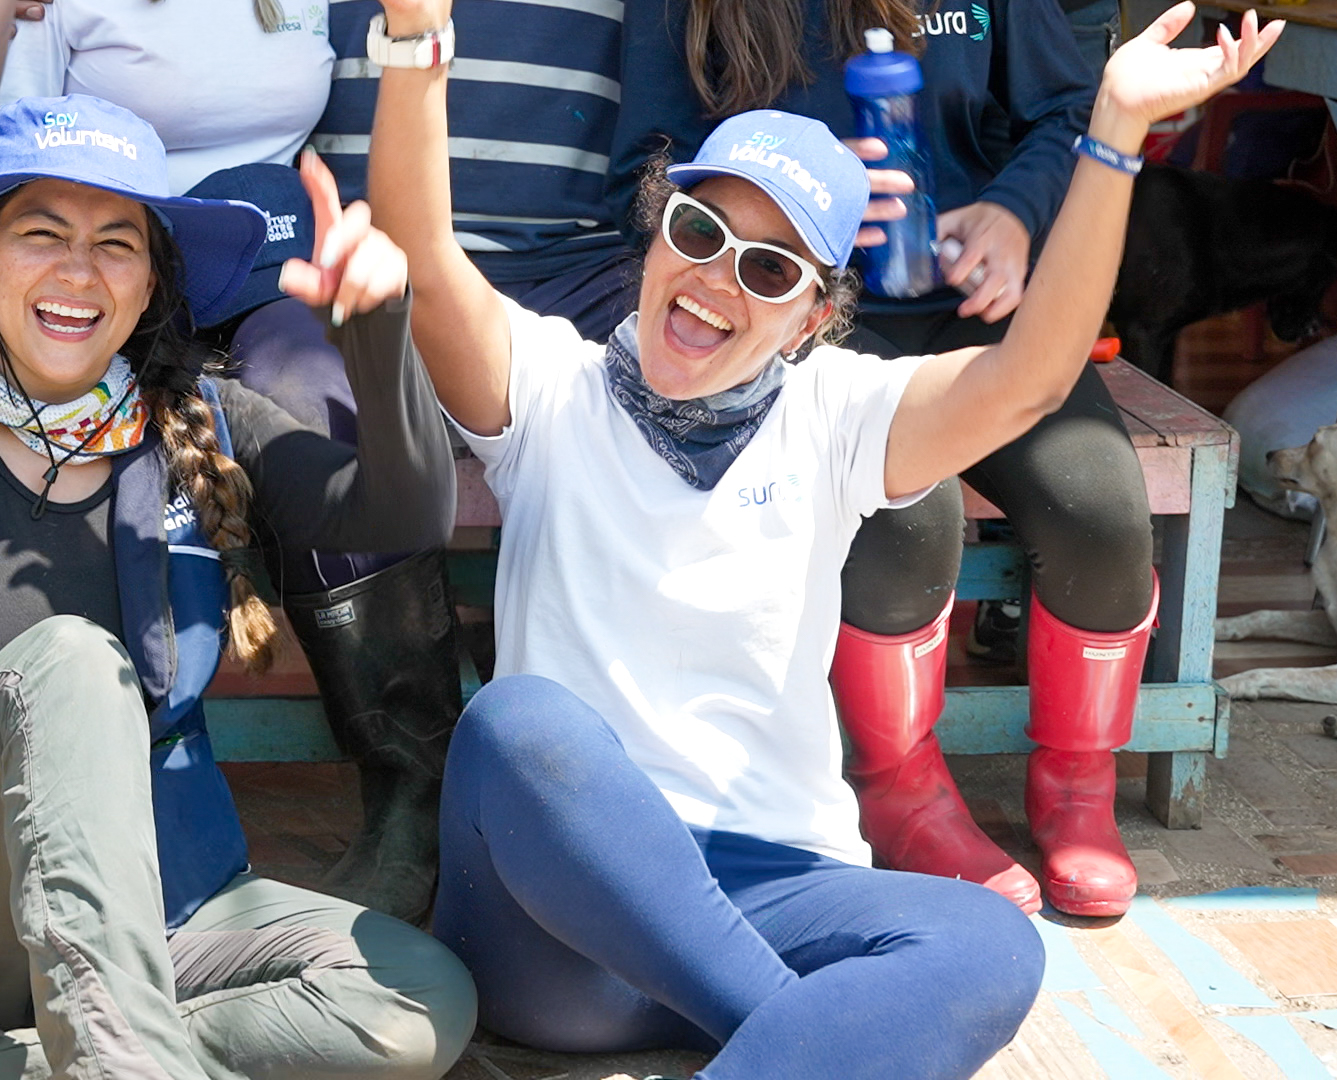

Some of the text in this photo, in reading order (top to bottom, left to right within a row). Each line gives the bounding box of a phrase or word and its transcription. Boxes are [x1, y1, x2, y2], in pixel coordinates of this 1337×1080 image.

[34, 126, 137, 161] Voluntario
[728, 143, 832, 212] Voluntario
[738, 481, 786, 508] sur
